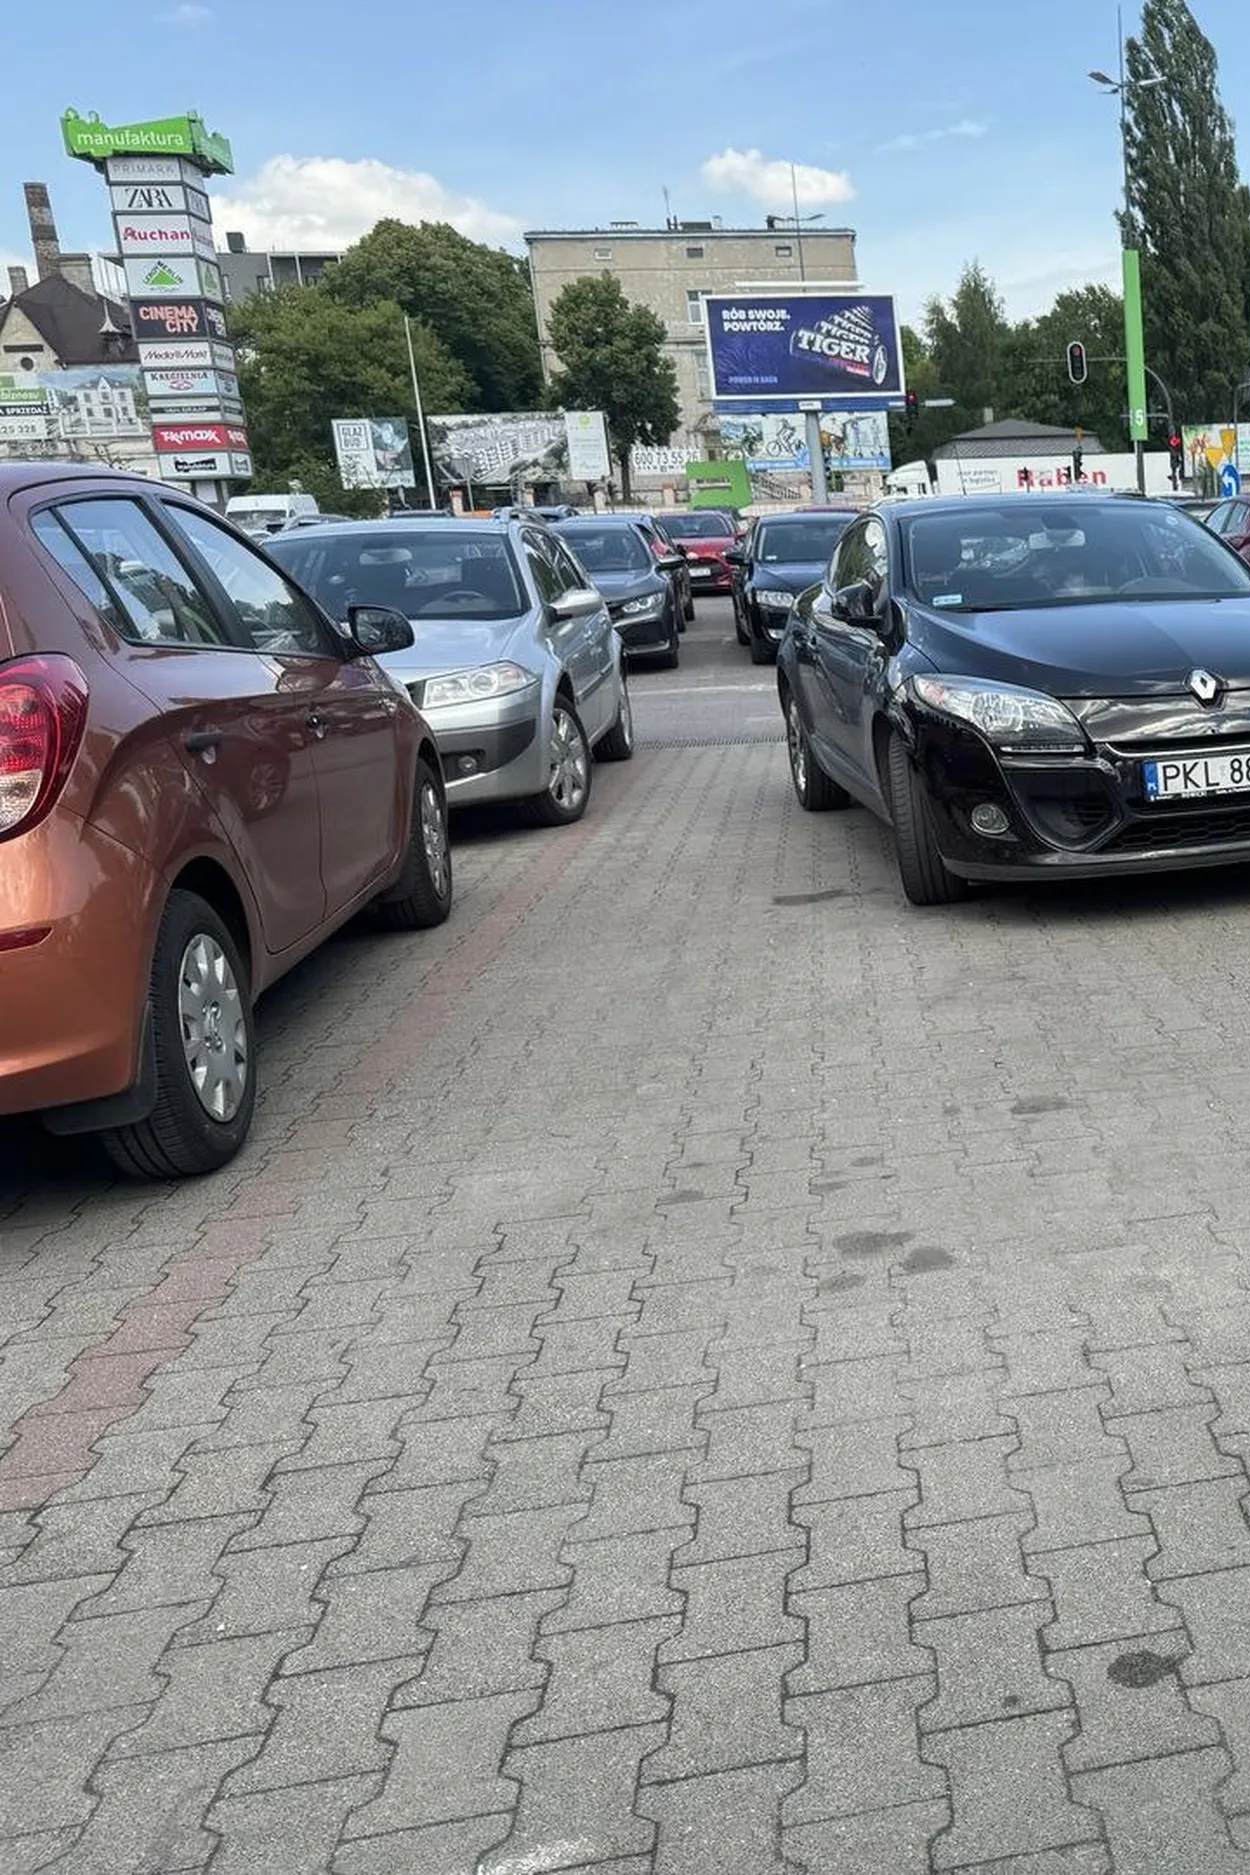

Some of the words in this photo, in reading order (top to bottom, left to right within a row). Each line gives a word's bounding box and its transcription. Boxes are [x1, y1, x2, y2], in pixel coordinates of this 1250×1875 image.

[77, 130, 184, 146] manufaktura
[113, 163, 175, 173] PRIMARK
[125, 187, 173, 208] ZARA
[123, 227, 190, 241] Auchan
[140, 305, 199, 320] CINEMA
[722, 306, 747, 320] RÓB
[747, 309, 791, 320] SWOJE.
[166, 319, 198, 333] CITY
[723, 320, 785, 331] POWTÓRZ.
[797, 329, 870, 364] TIGER
[1134, 409, 1144, 425] 5
[1162, 761, 1220, 792] PKL
